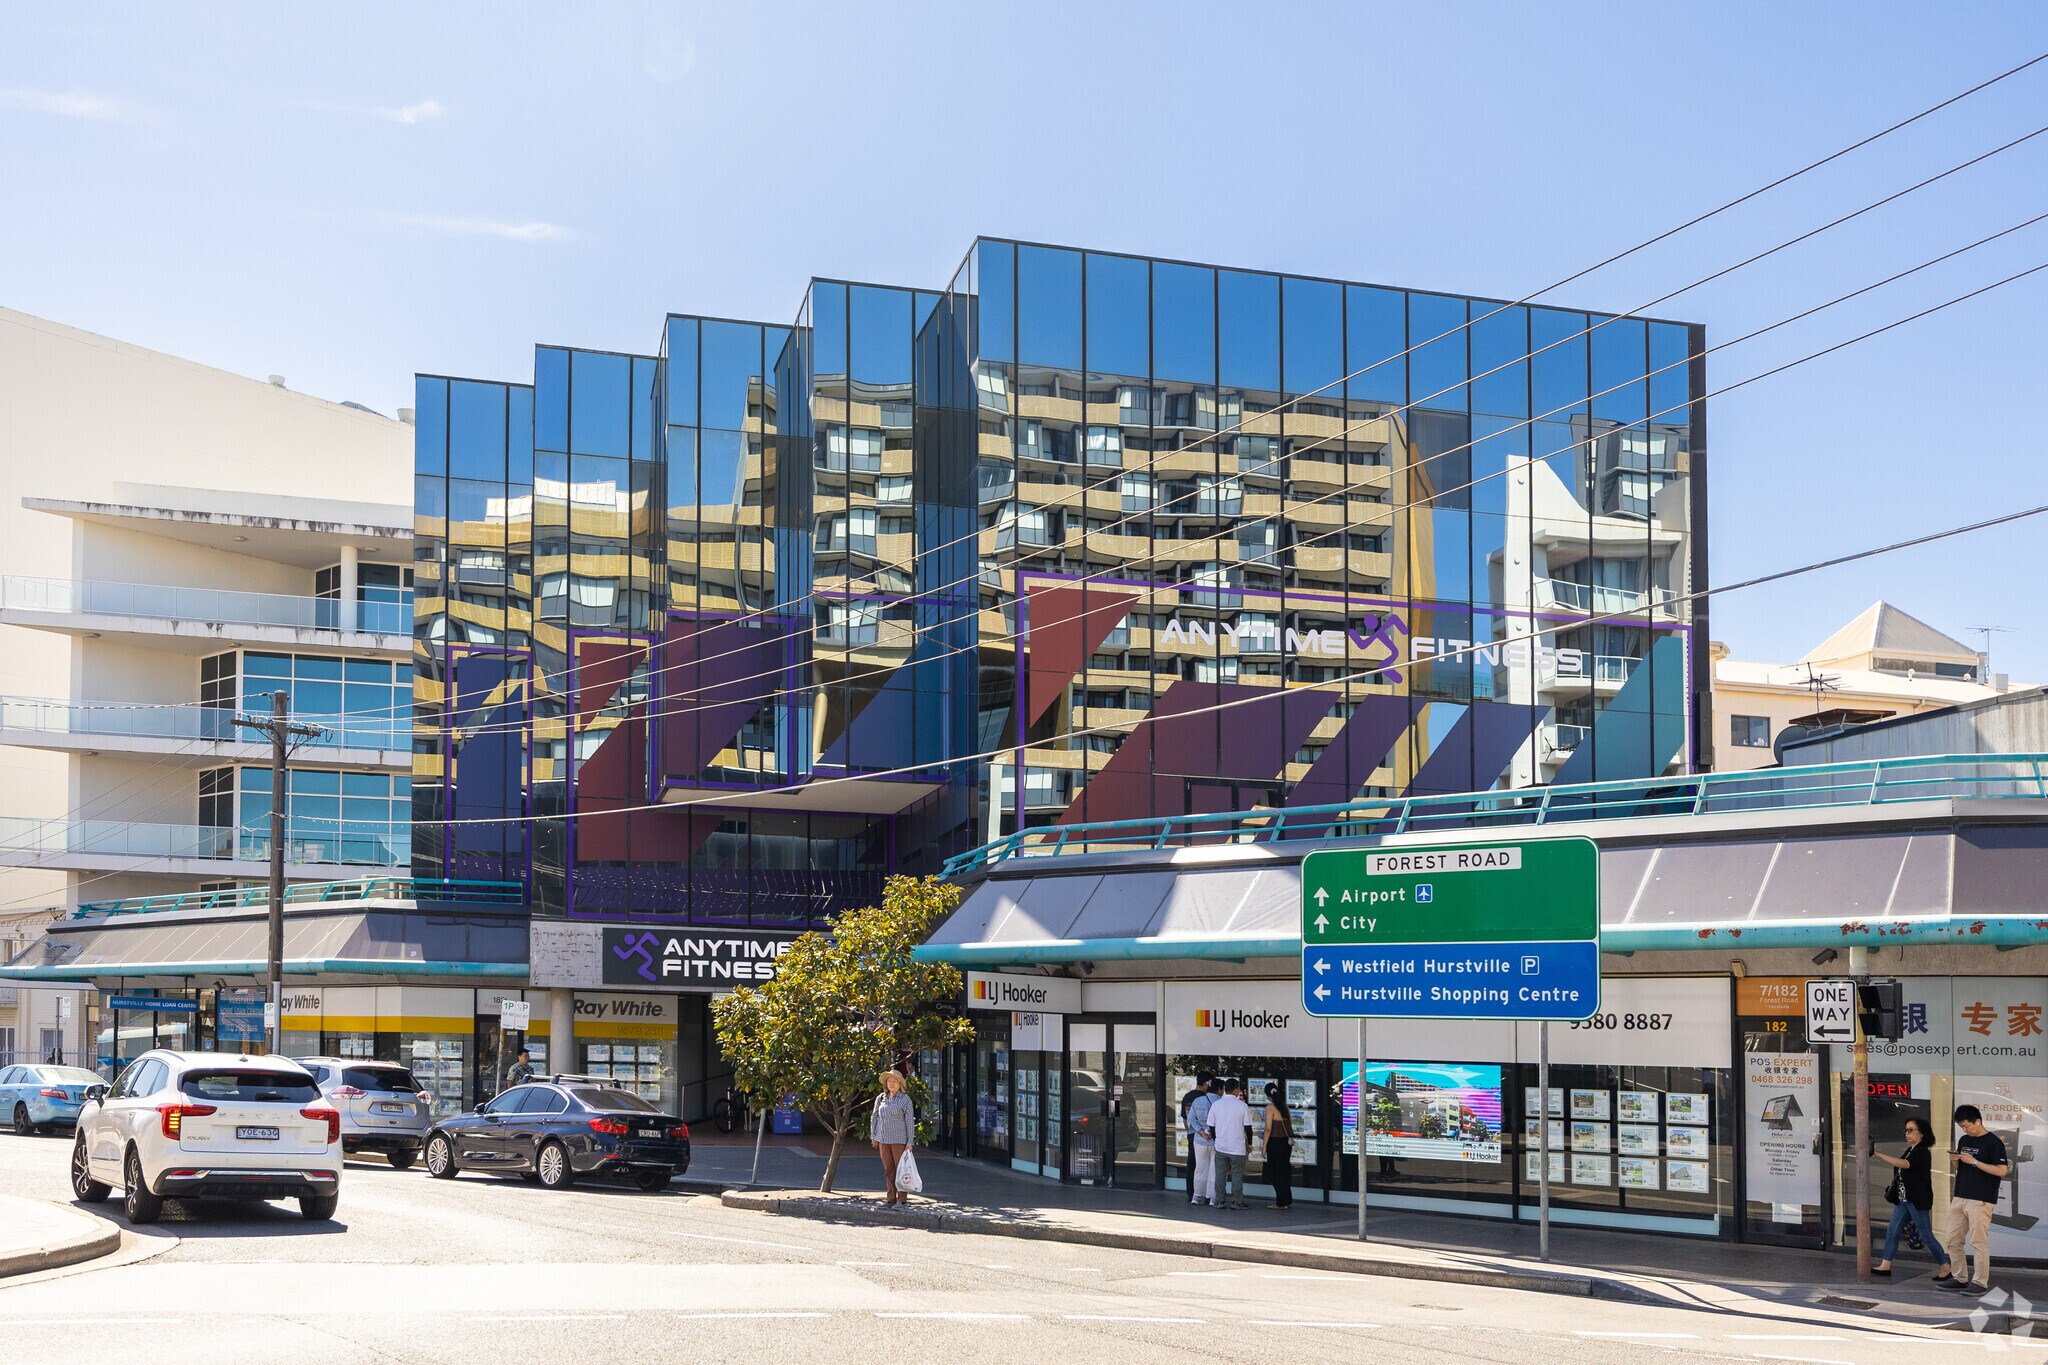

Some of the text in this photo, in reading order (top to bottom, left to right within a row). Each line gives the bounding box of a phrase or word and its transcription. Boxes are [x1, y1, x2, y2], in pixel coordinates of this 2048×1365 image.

[1160, 618, 1582, 672] ANYTIME FITNESS
[1376, 851, 1511, 871] FOREST ROAD
[1340, 888, 1406, 905] Airport
[1340, 916, 1377, 932] City
[662, 938, 795, 959] ANYTIME
[662, 959, 783, 980] FITNES
[1341, 959, 1415, 974] Westfield
[1424, 958, 1511, 973] Hurstville
[988, 981, 1047, 1005] LJ Hooker
[1341, 986, 1580, 1005] Hurstville Shopping Centre
[1760, 984, 1798, 996] 7/182
[1814, 988, 1848, 1002] ONE
[282, 994, 320, 1012] ay White
[574, 998, 663, 1018] Ray White
[1213, 1010, 1290, 1032] LJ Hooker
[1624, 1013, 1673, 1030] 8887
[1812, 1007, 1850, 1021] WAY
[1960, 1002, 2044, 1037] 专家
[617, 1026, 664, 1035] 9579 2311
[1764, 1021, 1788, 1032] 182
[1750, 1058, 1814, 1067] POS EXPERT
[1764, 1066, 1799, 1074] 收银专家
[1752, 1075, 1773, 1083] 0468
[1796, 1076, 1813, 1084] 298
[1868, 1084, 1908, 1096] OPEN
